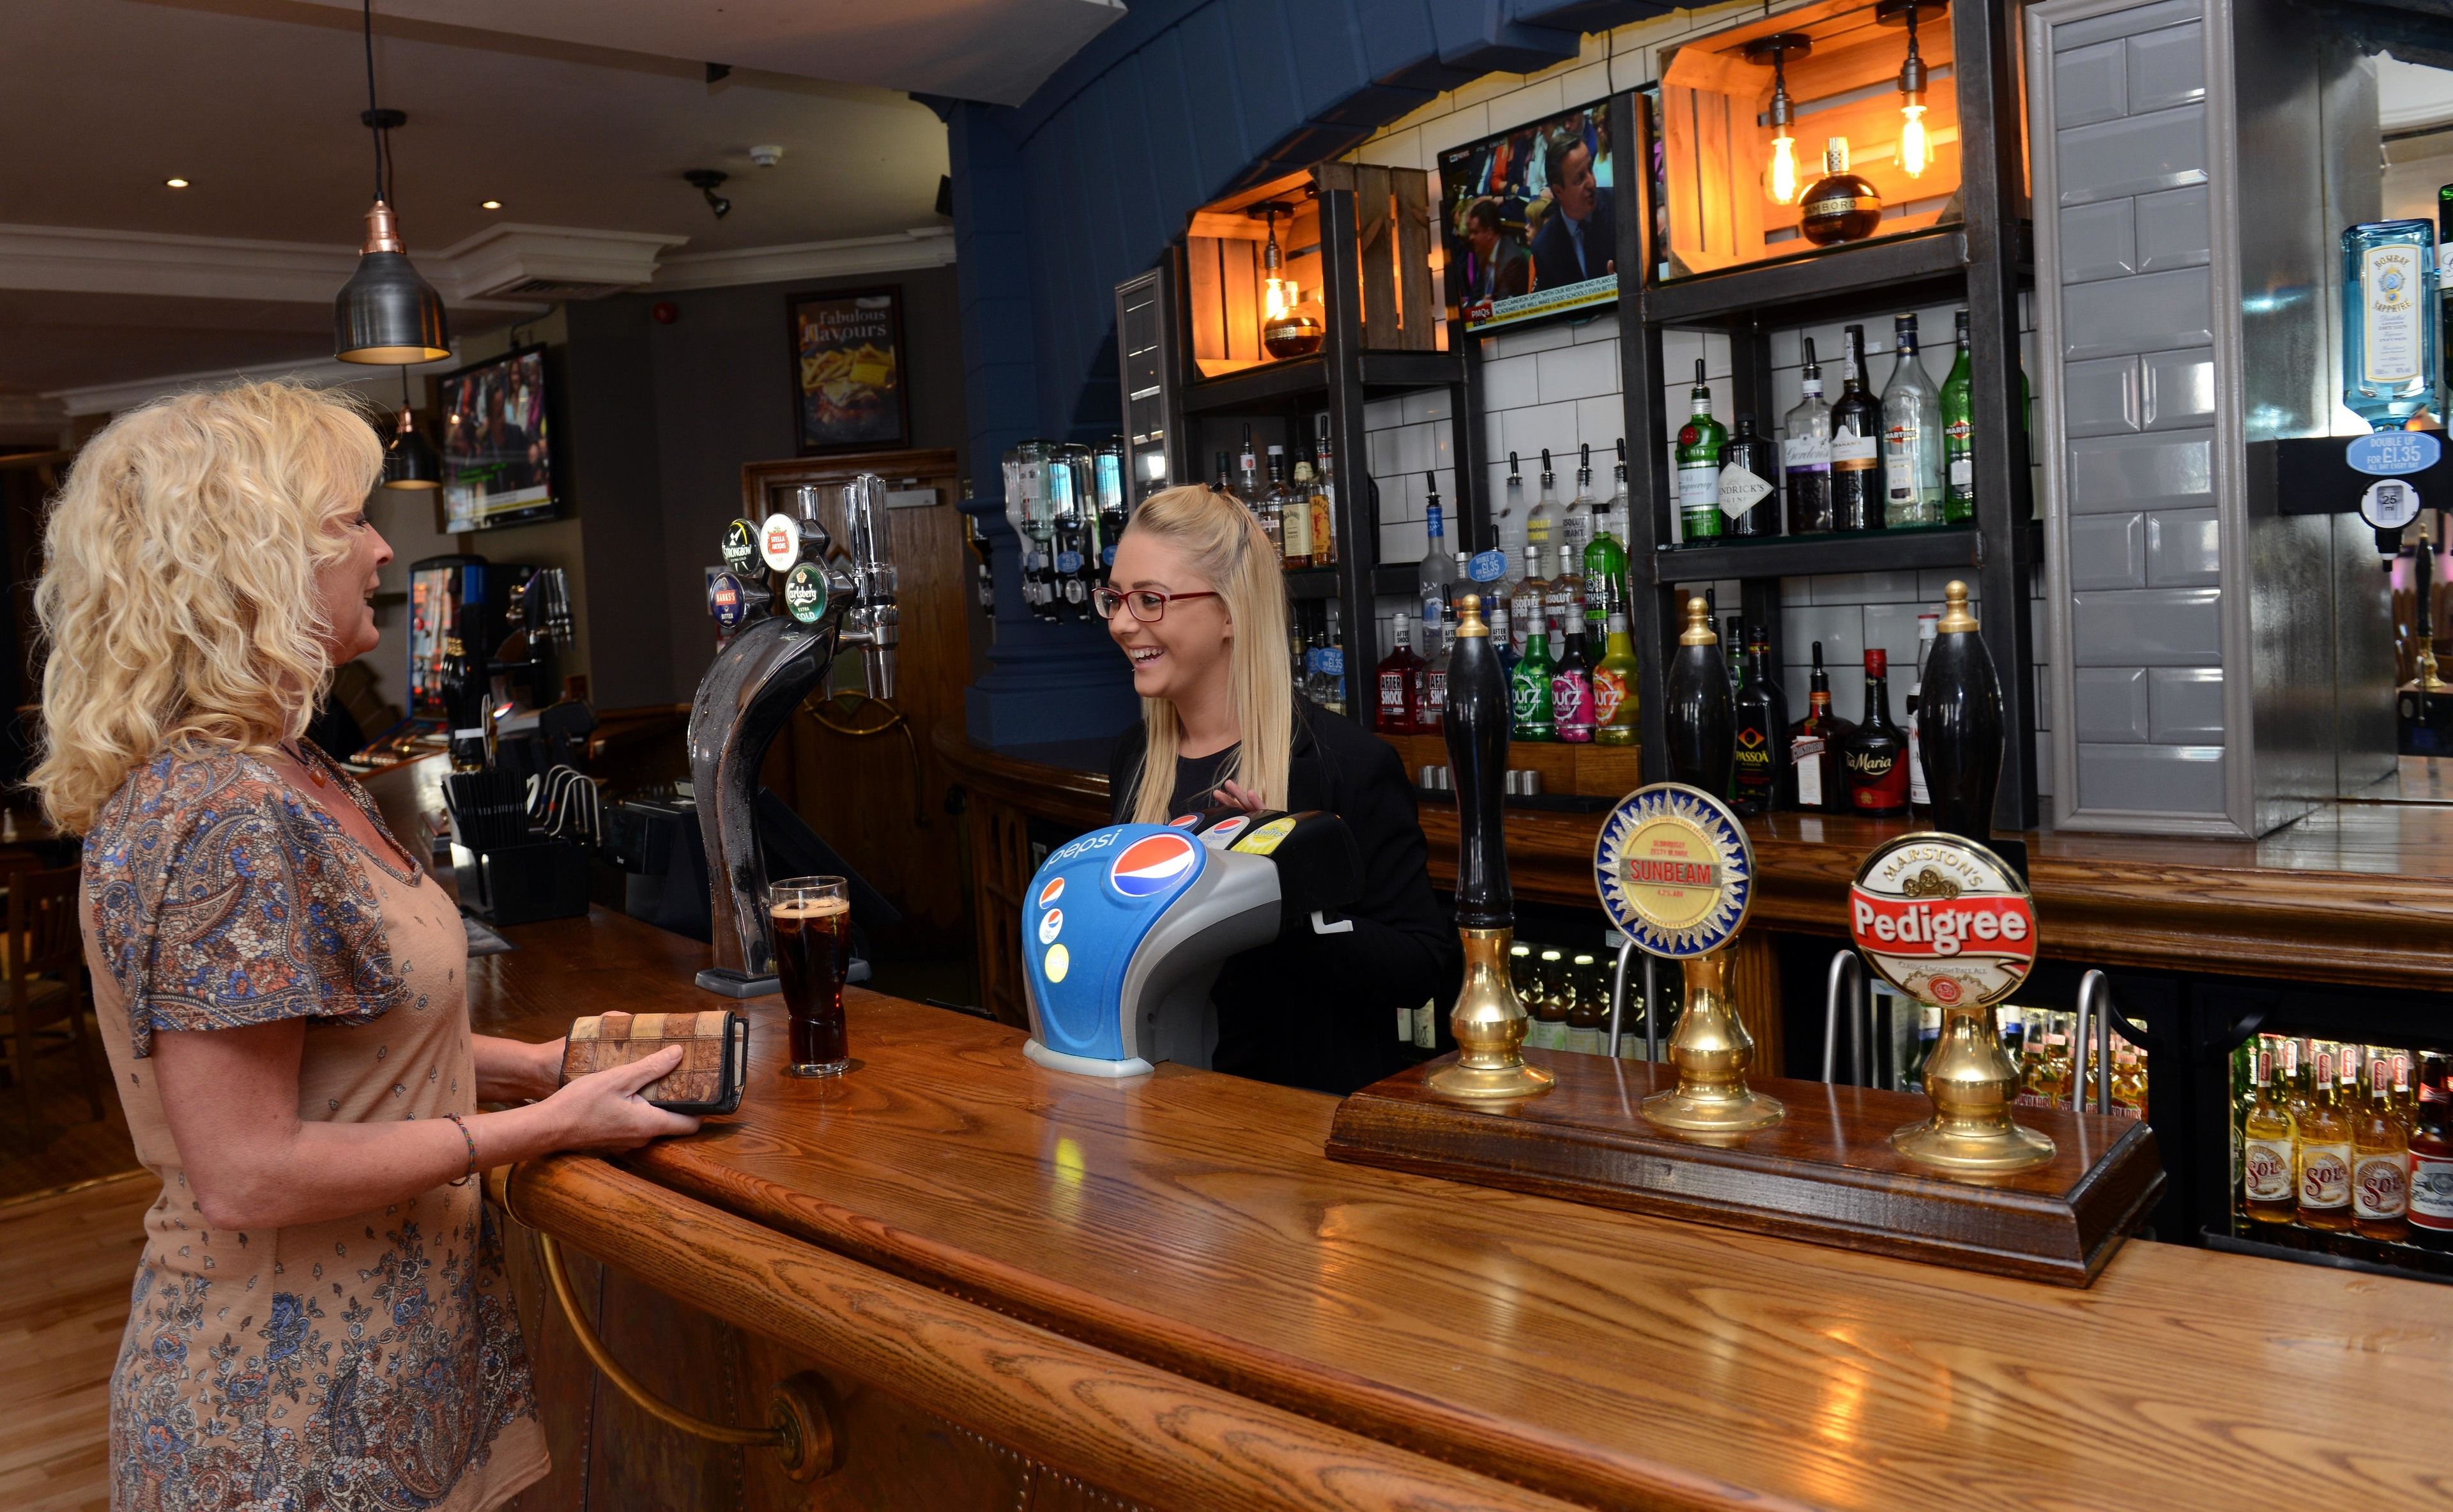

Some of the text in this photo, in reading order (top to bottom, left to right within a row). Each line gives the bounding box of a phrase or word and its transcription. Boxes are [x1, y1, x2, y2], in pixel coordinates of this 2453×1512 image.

[2374, 255, 2410, 268] BOMBAY
[1507, 295, 1528, 305] CAMERON
[1565, 282, 1584, 292] REFORM
[1596, 276, 1611, 285] PLANS
[1566, 289, 1587, 299] SCHOOLS
[1601, 282, 1617, 291] BETTE
[1471, 308, 1490, 318] PMQs
[2373, 298, 2413, 313] SAPPHIRE
[820, 309, 887, 325] fabulous
[804, 323, 887, 342] flavours
[1886, 430, 1916, 439] MARTINI
[2371, 436, 2417, 447] DOUBLE UP
[1787, 447, 1830, 461] Gordon's
[2367, 446, 2421, 464] FOR £1.35
[1718, 484, 1764, 495] ENDRICK'S
[2382, 495, 2397, 505] 25
[723, 544, 752, 560] STRONGBOW
[1482, 560, 1499, 574] £1.35
[716, 592, 735, 602] BANKS'S
[787, 583, 818, 603] Carlsberg
[797, 611, 816, 621] COLD
[1380, 675, 1403, 691] AFTER
[1430, 674, 1446, 690] AFT
[1381, 690, 1403, 705] SHOCK
[1513, 689, 1541, 704] ourz
[1552, 690, 1582, 705] ourz
[1855, 753, 1891, 770] Maria
[1043, 829, 1122, 872] pepsi
[1653, 840, 1686, 849] GLORIOUSLY
[1630, 859, 1711, 885] SUNBEAM
[1883, 847, 1983, 887] MARSTON'S
[1854, 899, 2028, 956] Pedigree
[1898, 961, 1924, 970] CLASSIC
[2246, 1159, 2282, 1189] SOL
[2304, 1165, 2345, 1198] SOL
[2362, 1175, 2404, 1207] SOL
